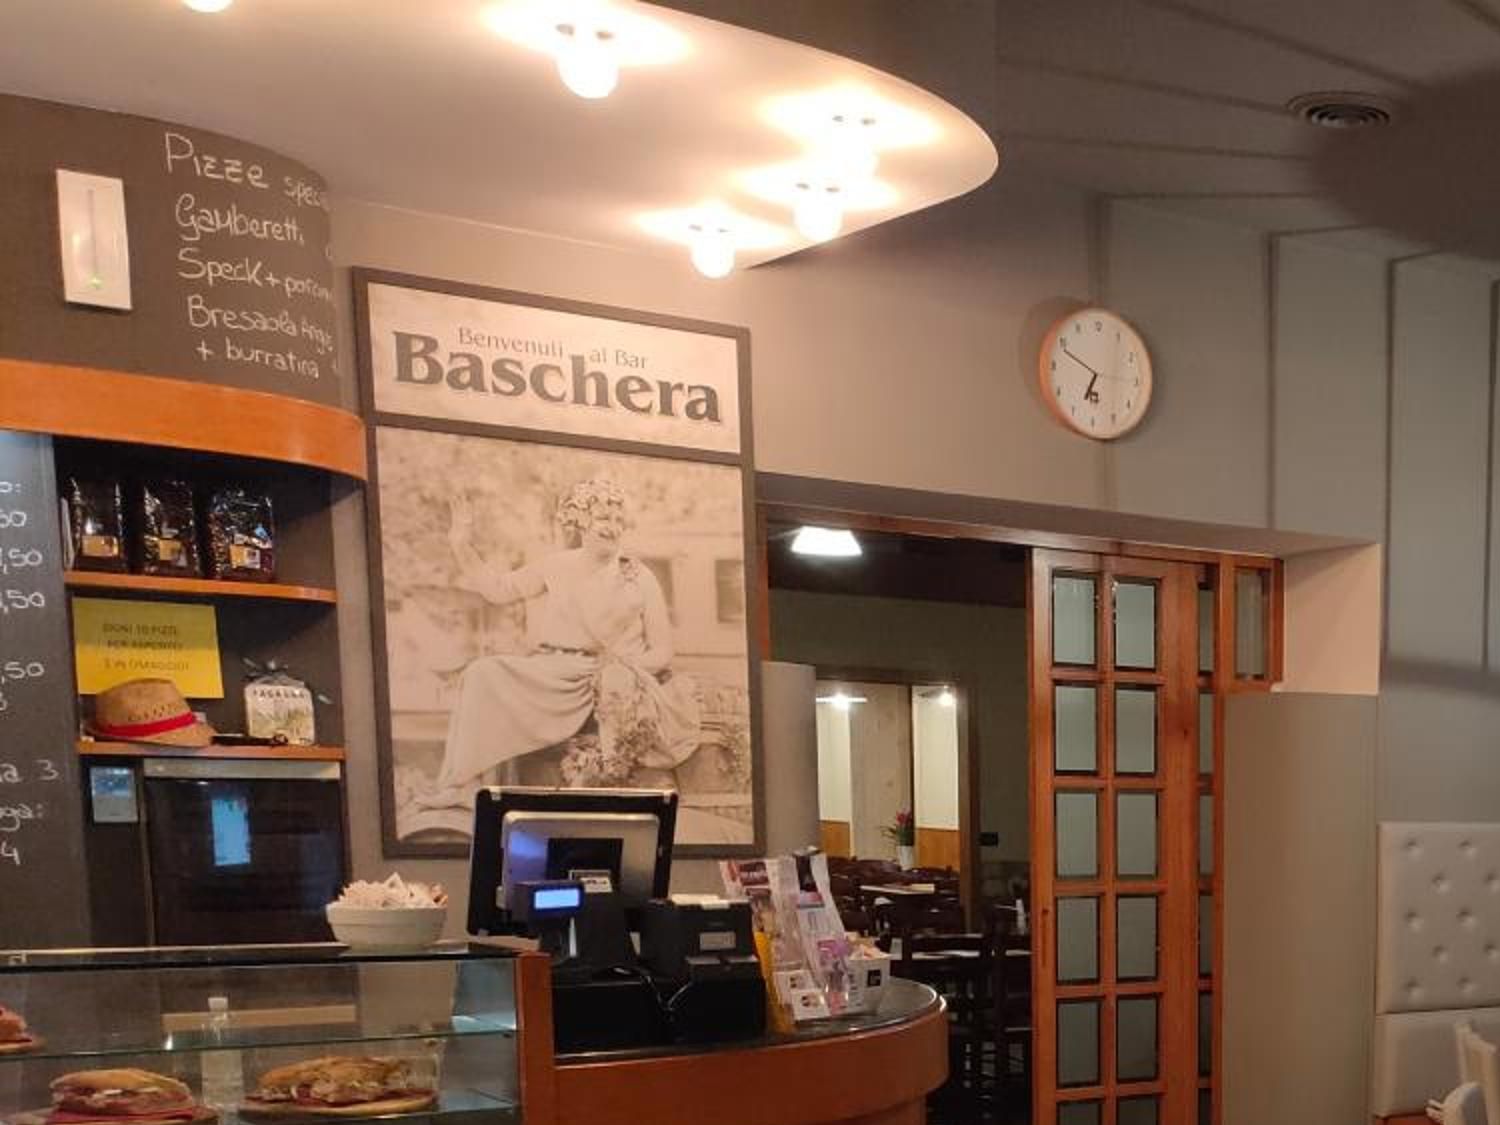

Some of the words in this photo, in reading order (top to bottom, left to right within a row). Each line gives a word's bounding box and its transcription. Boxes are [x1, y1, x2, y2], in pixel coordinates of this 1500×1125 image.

[164, 131, 269, 190] Pizze
[178, 248, 262, 287] Speck
[188, 294, 297, 336] Bresaola
[457, 326, 564, 359] Benvenuti
[589, 349, 607, 364] al
[615, 349, 648, 370] Bar
[392, 330, 722, 423] Baschera
[0, 548, 43, 575] ,50
[0, 588, 46, 614] ,50
